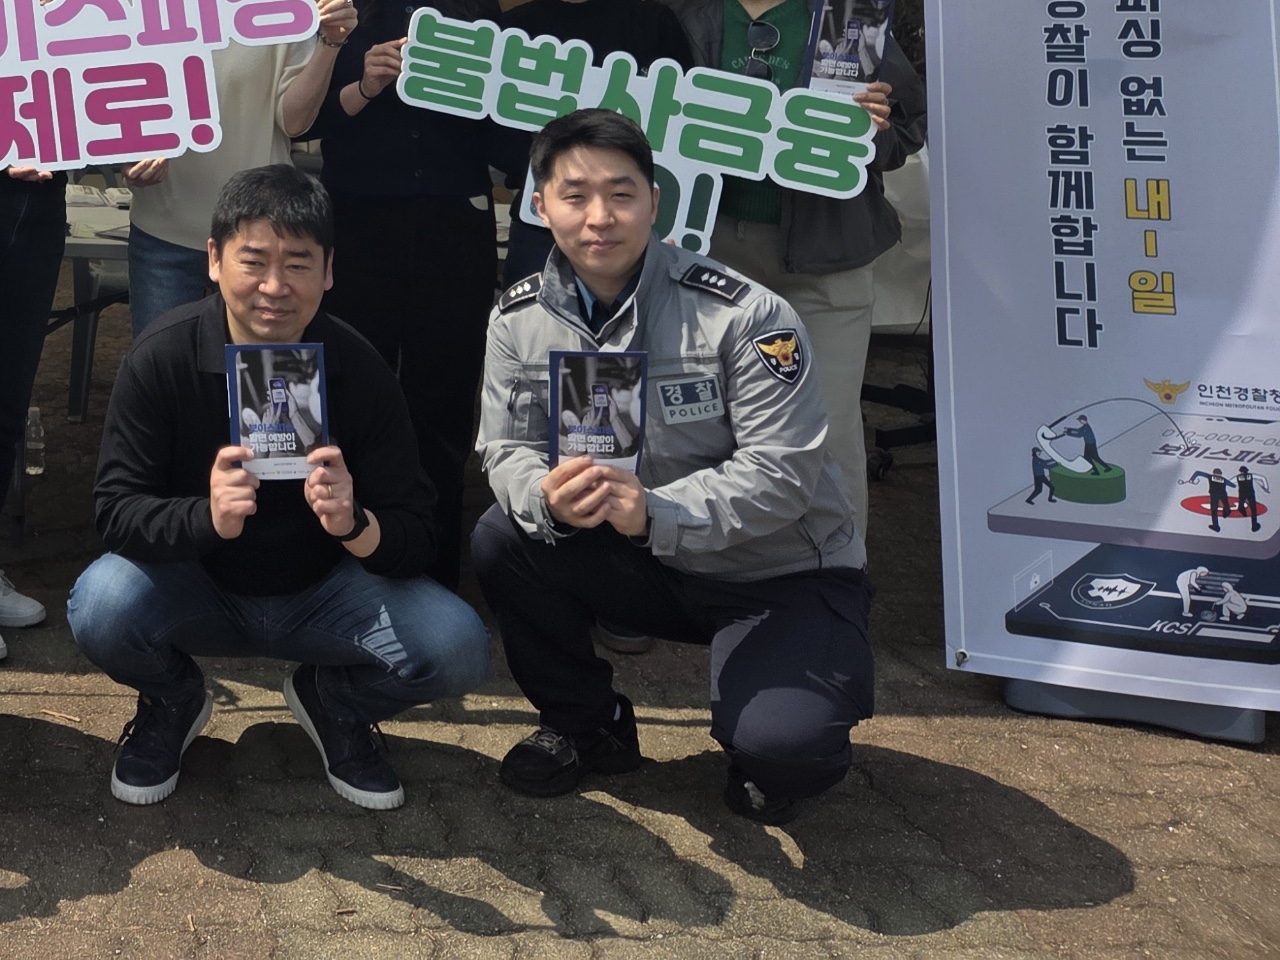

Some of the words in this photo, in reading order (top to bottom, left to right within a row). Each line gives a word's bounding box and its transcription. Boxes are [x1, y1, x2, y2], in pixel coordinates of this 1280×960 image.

[404, 13, 873, 194] 불법사금융
[1119, 75, 1168, 163] 없는
[1045, 123, 1104, 349] 함께합니다
[669, 401, 719, 419] POLICE
